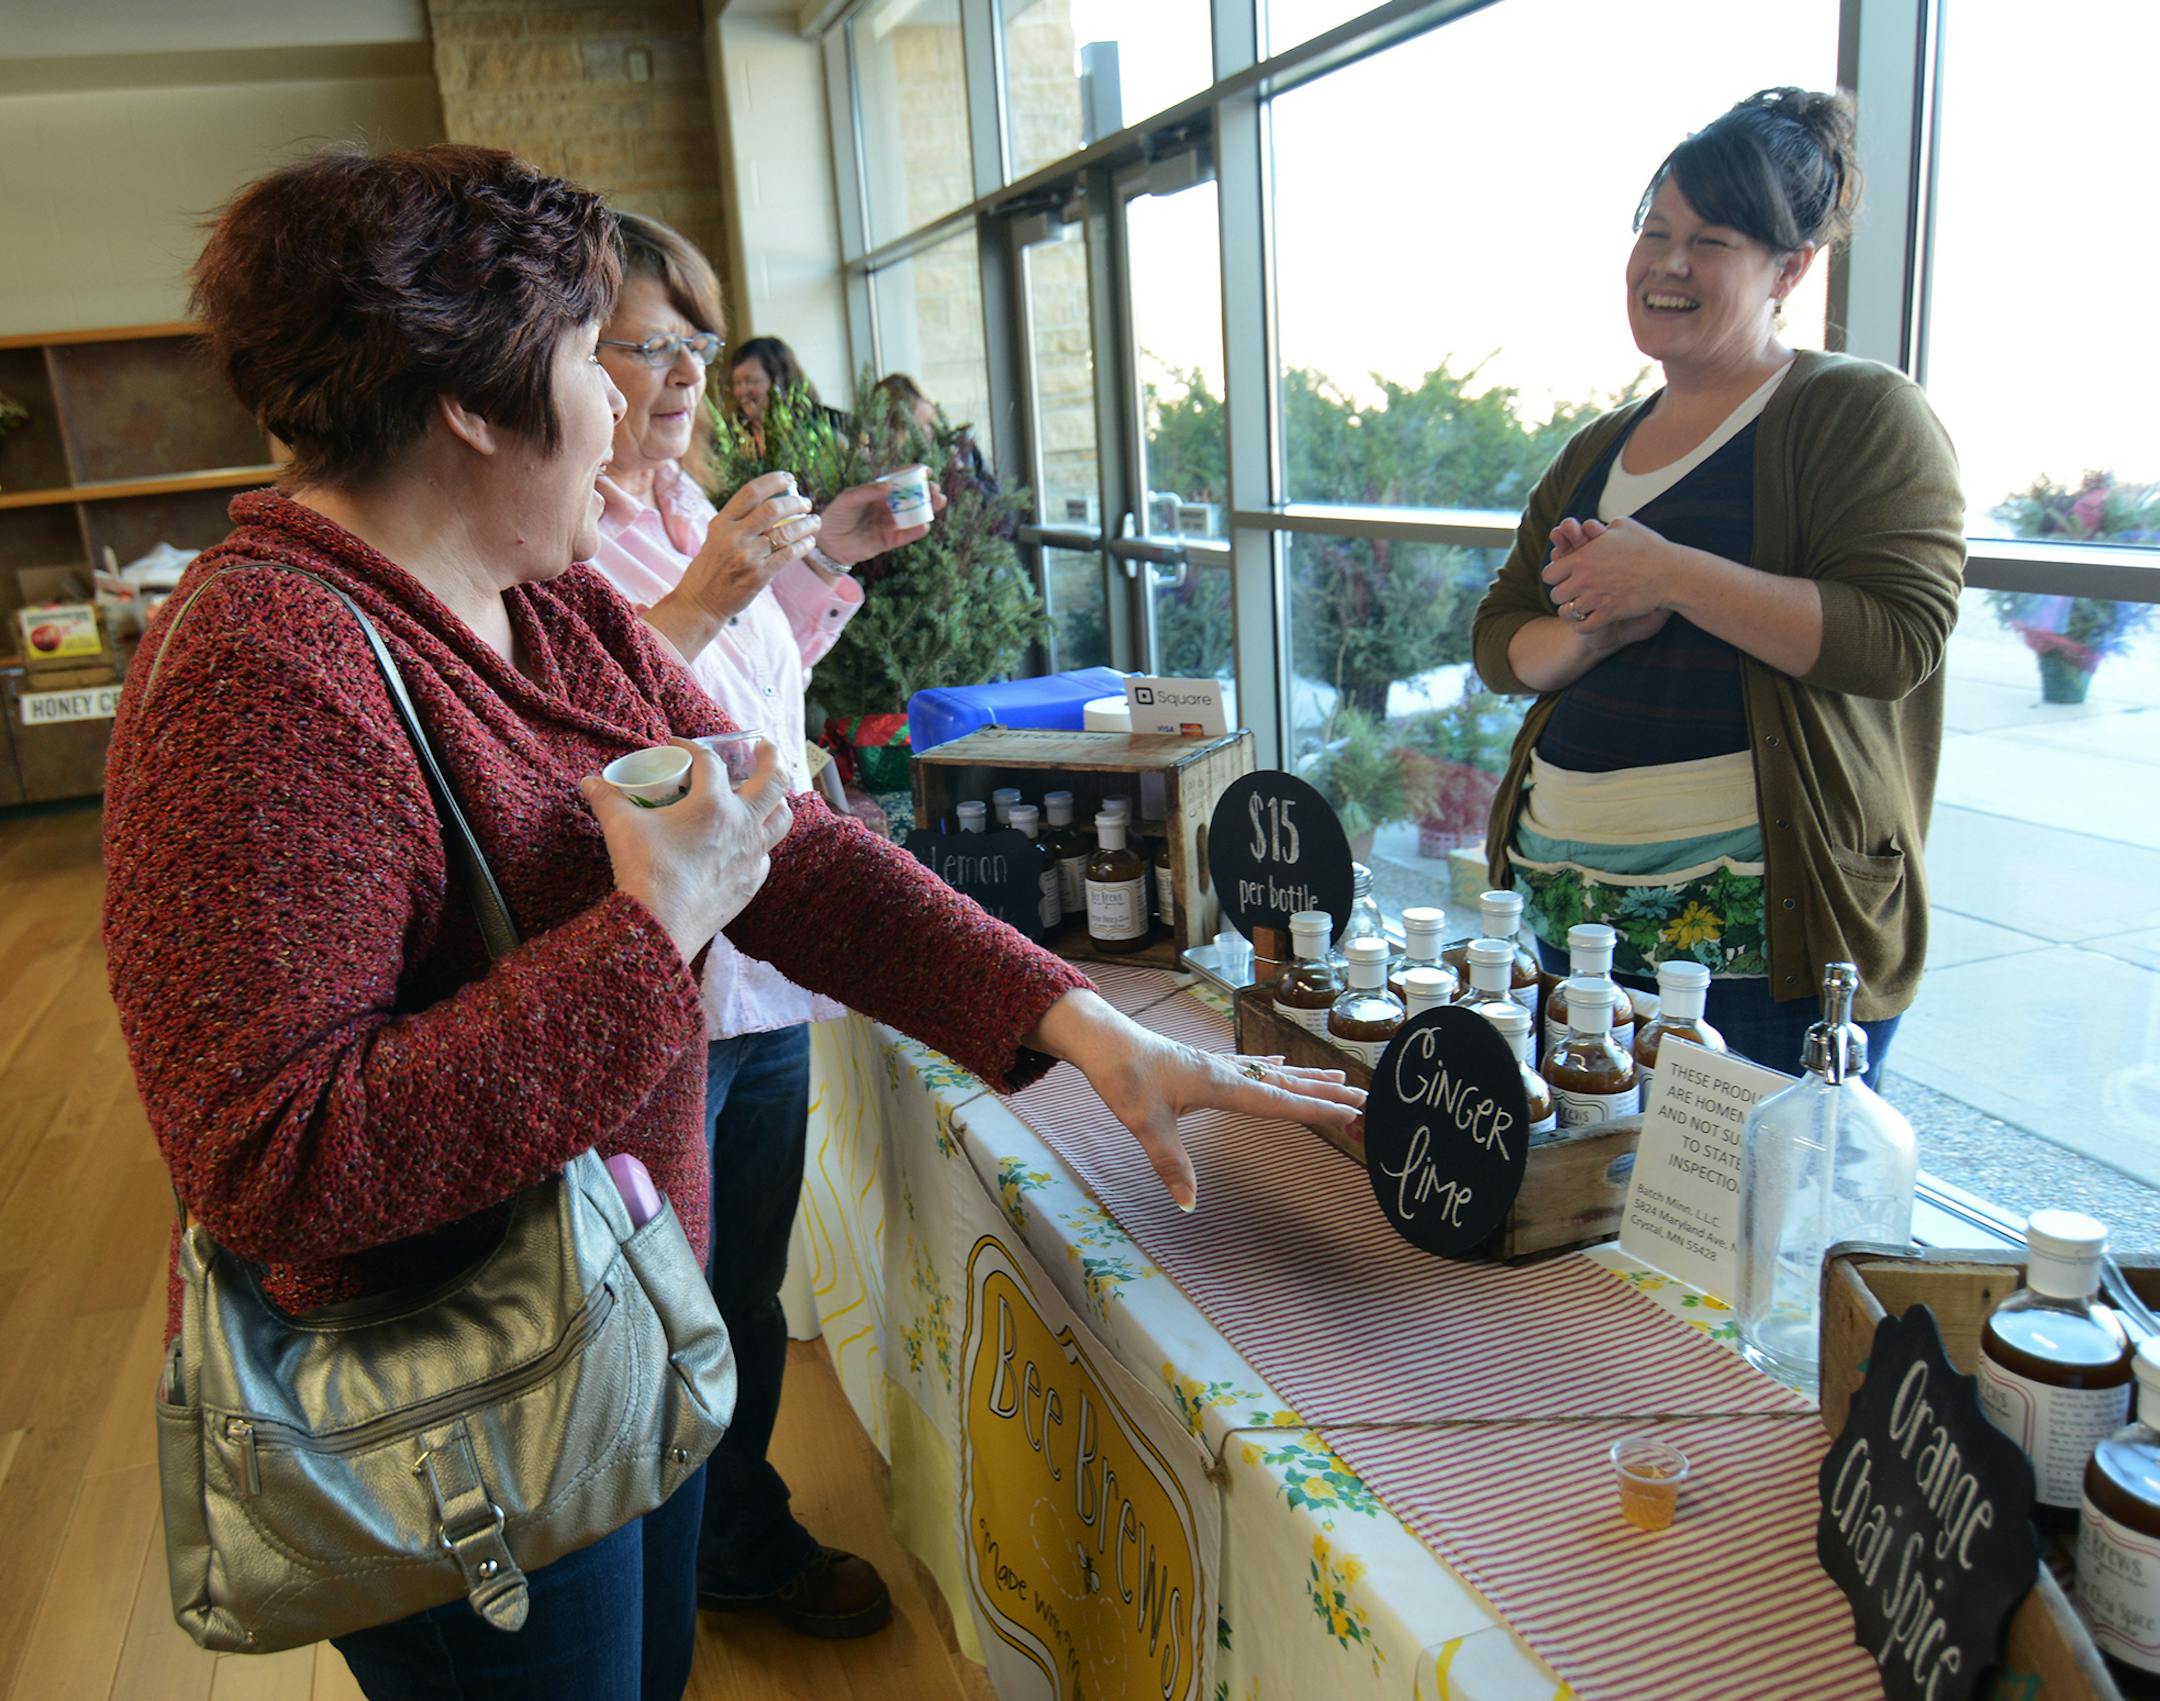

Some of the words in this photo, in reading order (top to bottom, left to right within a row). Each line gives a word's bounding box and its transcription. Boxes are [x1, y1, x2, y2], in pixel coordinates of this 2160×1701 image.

[33, 694, 93, 719] HONEY
[1157, 690, 1213, 707] Square
[1156, 725, 1175, 733] VISA
[1248, 790, 1300, 865] $15
[1239, 879, 1266, 913] per
[1268, 874, 1319, 913] bottle
[1667, 1085, 1693, 1104] ARE
[1671, 1062, 1711, 1088] THESE
[1712, 1077, 1763, 1105] PRODU
[1657, 1104, 1687, 1125] AND
[1690, 1116, 1720, 1137] NOT
[1722, 1128, 1742, 1147] SU
[1682, 1135, 1700, 1153] TO
[1703, 1144, 1742, 1171] STATE
[1637, 1183, 1664, 1202] Batch
[1668, 1153, 1740, 1194] INSPECTIO
[1633, 1198, 1658, 1216] 5824
[1659, 1209, 1705, 1239] Maryland
[1666, 1231, 1685, 1246] MN
[1686, 1240, 1718, 1262] 55428
[989, 1294, 1064, 1481] Bee
[1889, 1359, 1994, 1571] Orange
[1830, 1437, 1904, 1588] Chai
[1877, 1531, 1962, 1701] Spice
